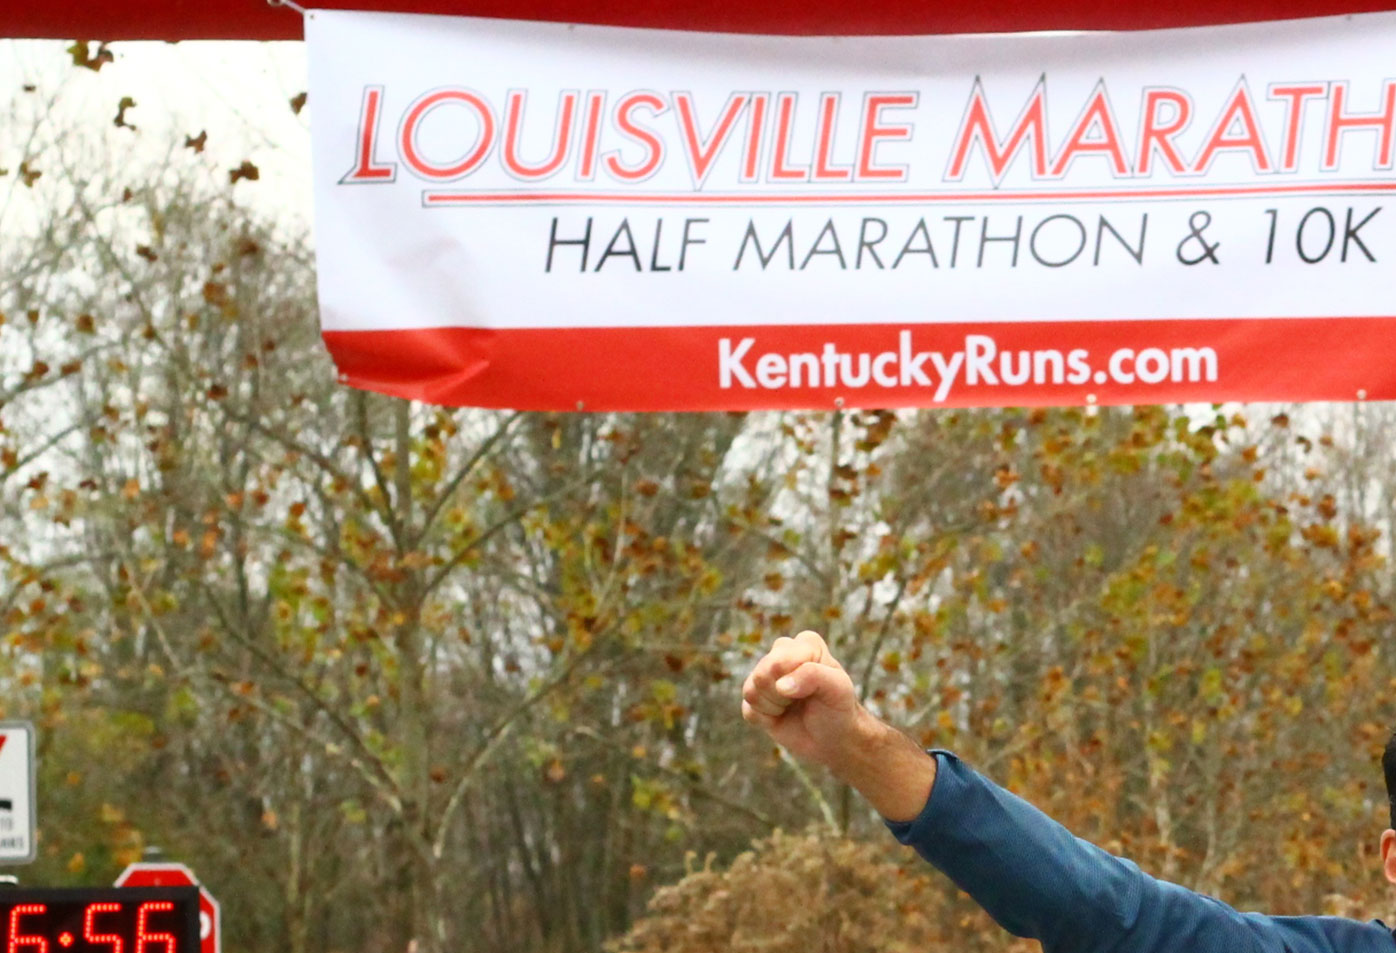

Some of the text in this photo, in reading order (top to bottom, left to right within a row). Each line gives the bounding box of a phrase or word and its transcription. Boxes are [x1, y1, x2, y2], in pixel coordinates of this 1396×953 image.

[337, 84, 920, 191] LOUISVILLE
[544, 206, 1383, 273] HALF MARATHON & 10K
[718, 331, 1218, 402] KentuckyRuns.com
